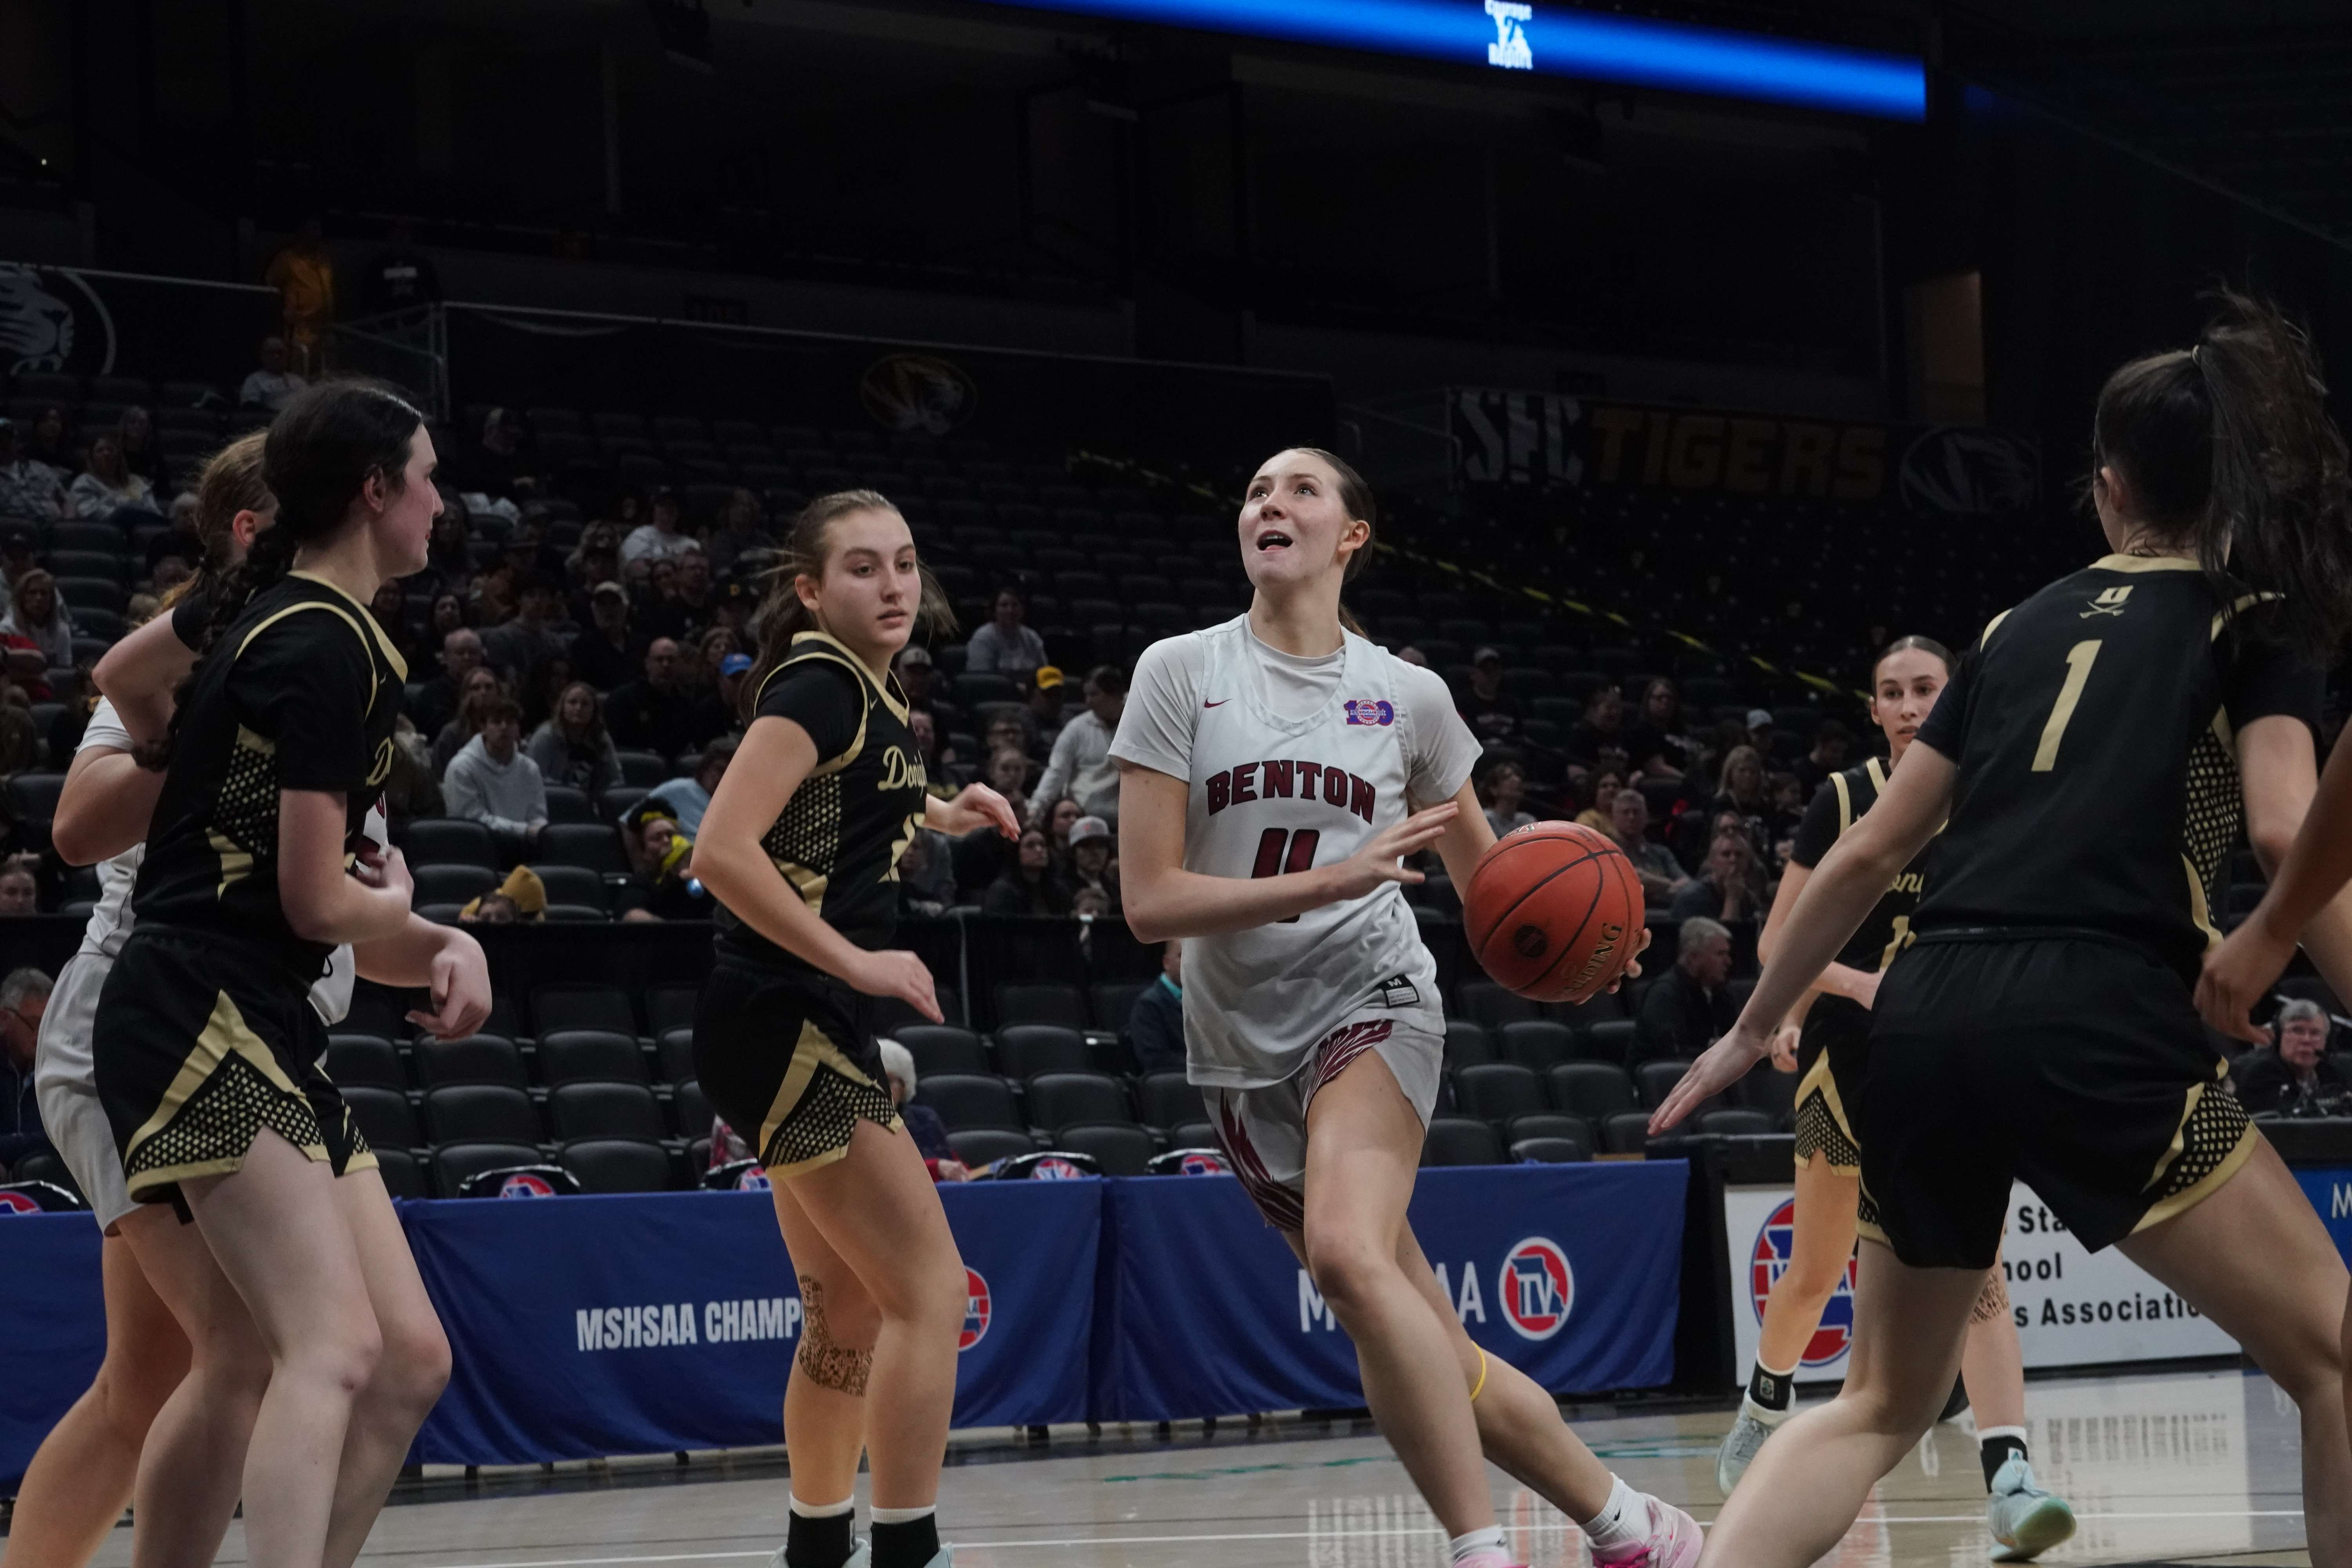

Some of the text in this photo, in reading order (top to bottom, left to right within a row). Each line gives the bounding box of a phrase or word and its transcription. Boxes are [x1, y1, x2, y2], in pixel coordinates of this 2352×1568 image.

[1590, 406, 1885, 499] TIGERS
[2031, 639, 2103, 772] 1
[1206, 760, 1375, 825] BENTON
[1387, 978, 1402, 987] M
[576, 1297, 803, 1352] MSHSAA CHAMP
[1516, 1272, 1555, 1317] TV
